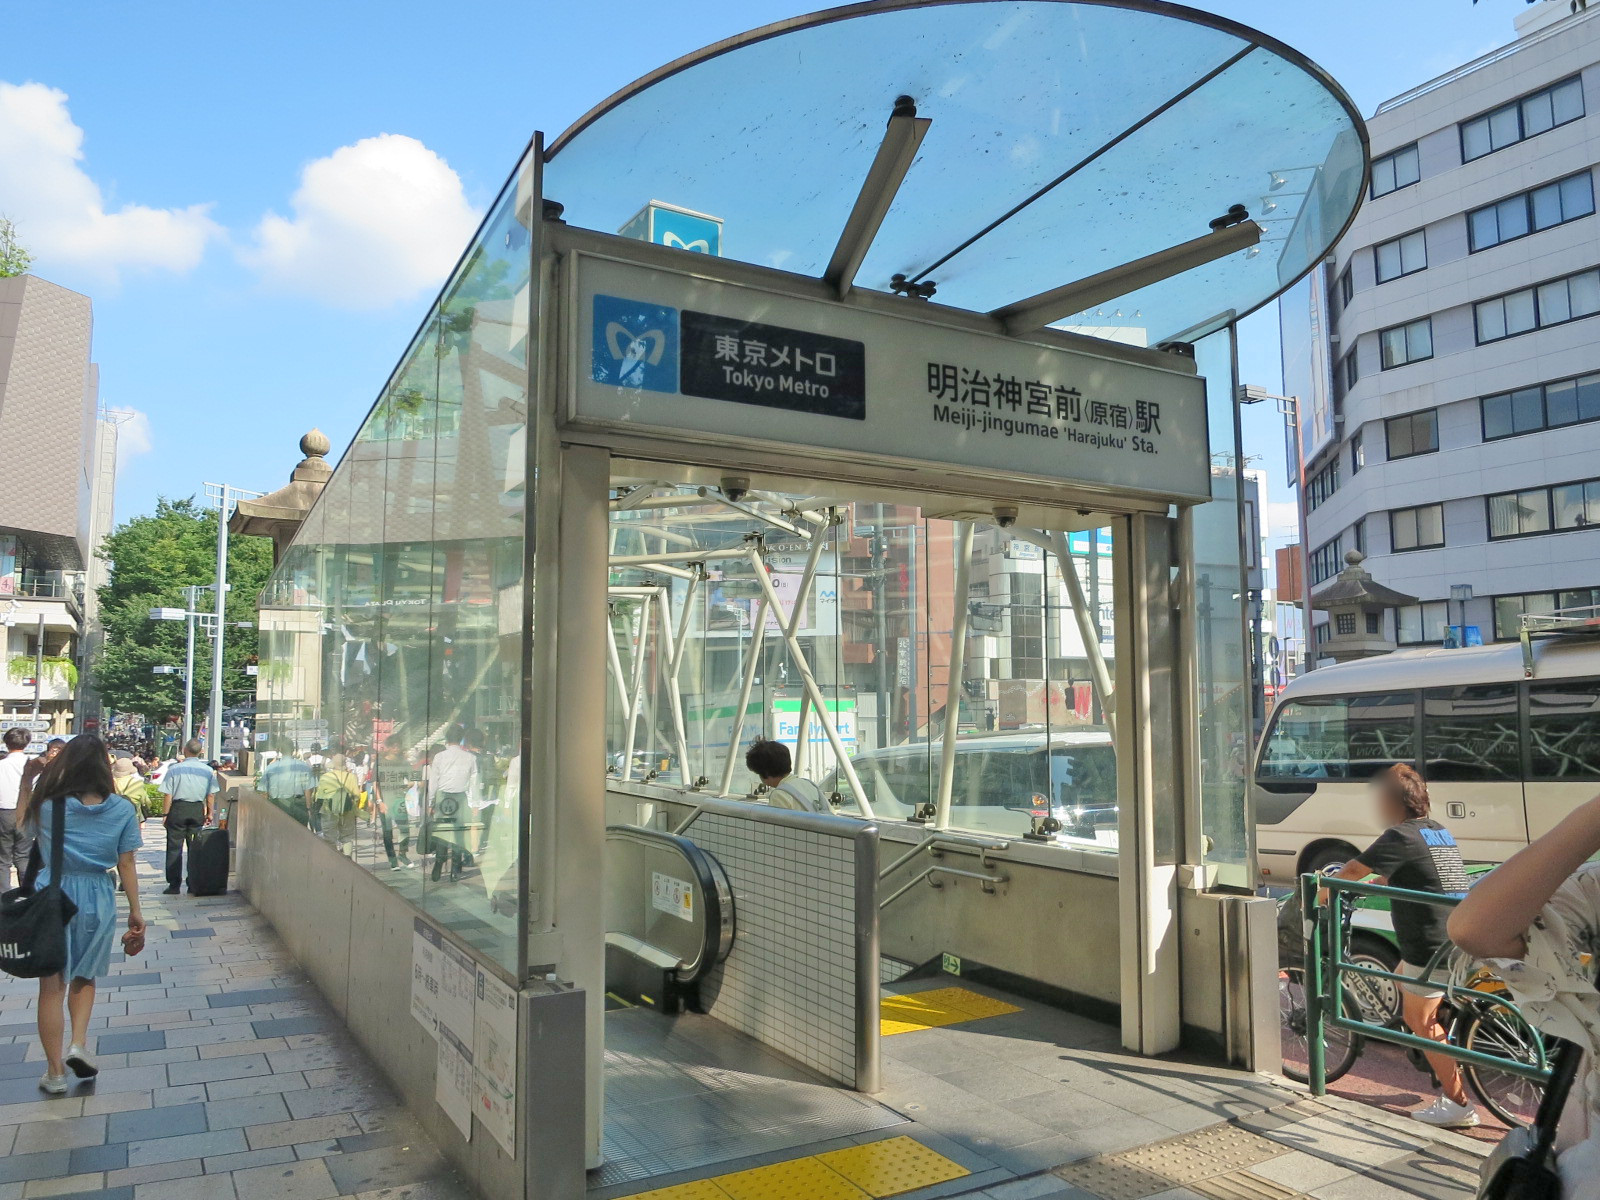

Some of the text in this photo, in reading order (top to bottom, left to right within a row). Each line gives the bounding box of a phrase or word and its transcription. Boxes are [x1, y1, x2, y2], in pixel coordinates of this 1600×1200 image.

[714, 335, 836, 377] 東京メトロ
[722, 366, 829, 398] Tokyo Metro
[933, 404, 1159, 455] Meiji-jingumae 'Harajuku' Sta.
[779, 721, 850, 736] Falyrt
